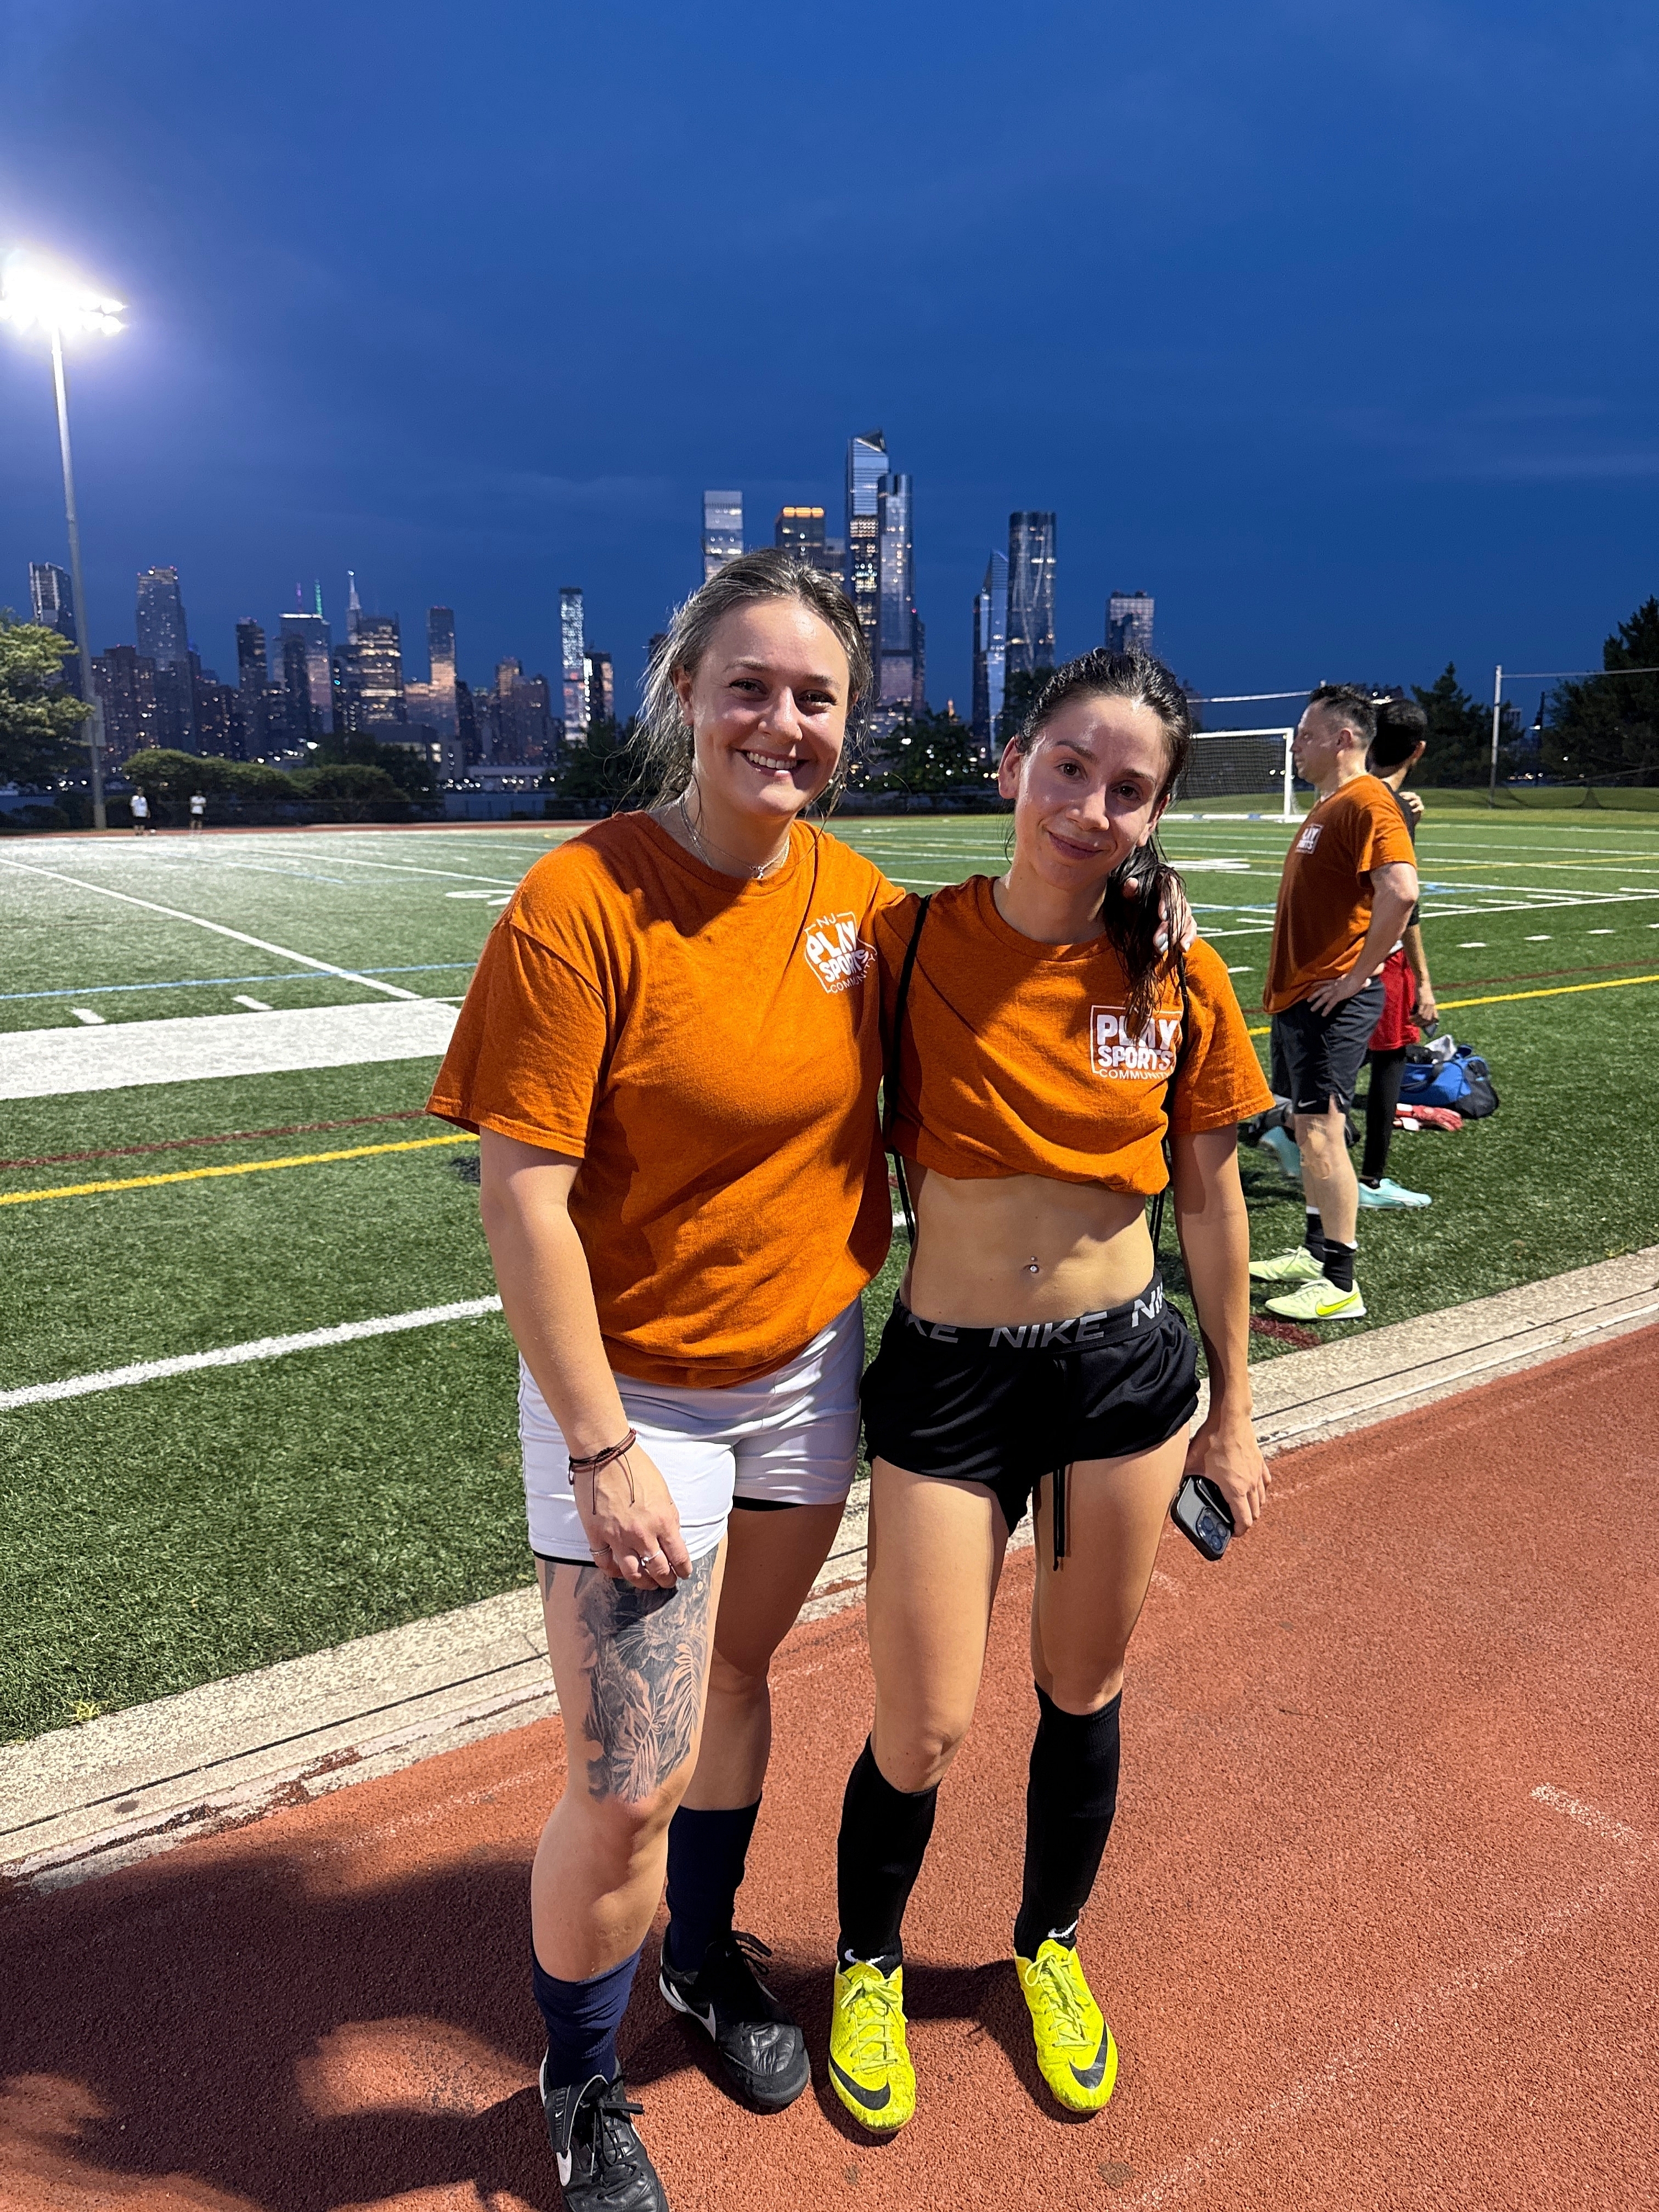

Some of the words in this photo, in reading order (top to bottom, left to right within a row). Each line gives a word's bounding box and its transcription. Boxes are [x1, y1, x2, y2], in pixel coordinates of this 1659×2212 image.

[816, 912, 837, 929] NJ
[806, 921, 856, 964] PLAY
[819, 949, 869, 983] SPORTS
[830, 953, 876, 994] COMMUNITY
[1098, 1045, 1173, 1071] SPORTS
[1099, 1068, 1171, 1080] COMMUNITY
[904, 1313, 959, 1344] KE
[989, 1311, 1108, 1348] NIKE
